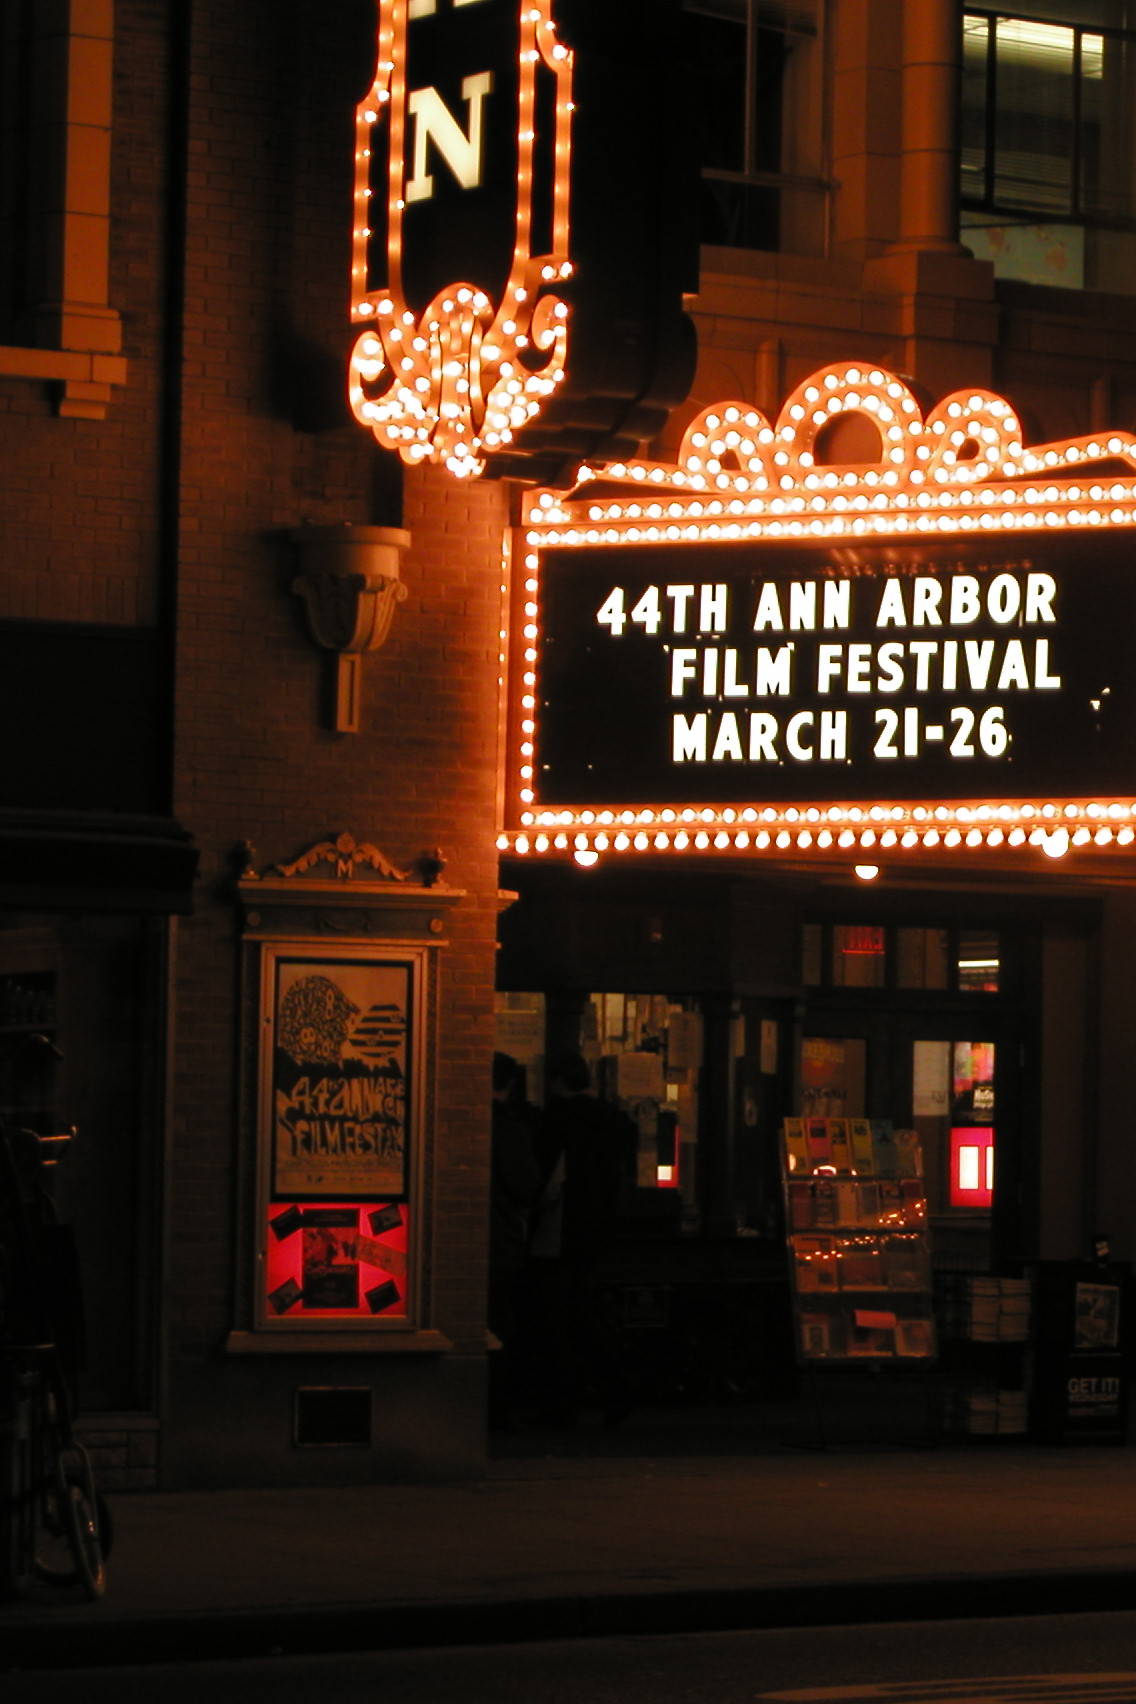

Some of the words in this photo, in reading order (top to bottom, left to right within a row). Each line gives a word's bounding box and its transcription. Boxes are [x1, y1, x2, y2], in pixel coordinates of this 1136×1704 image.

[596, 583, 728, 636] 44TH
[753, 579, 851, 632] ANN
[875, 572, 1057, 628] ARBOR
[671, 645, 795, 698] FILM
[817, 638, 1061, 694] FESTIVAL
[672, 708, 847, 762] MARCH
[873, 706, 1008, 758] 21-26
[1067, 1377, 1098, 1393] GET
[1101, 1377, 1119, 1393] IT!
